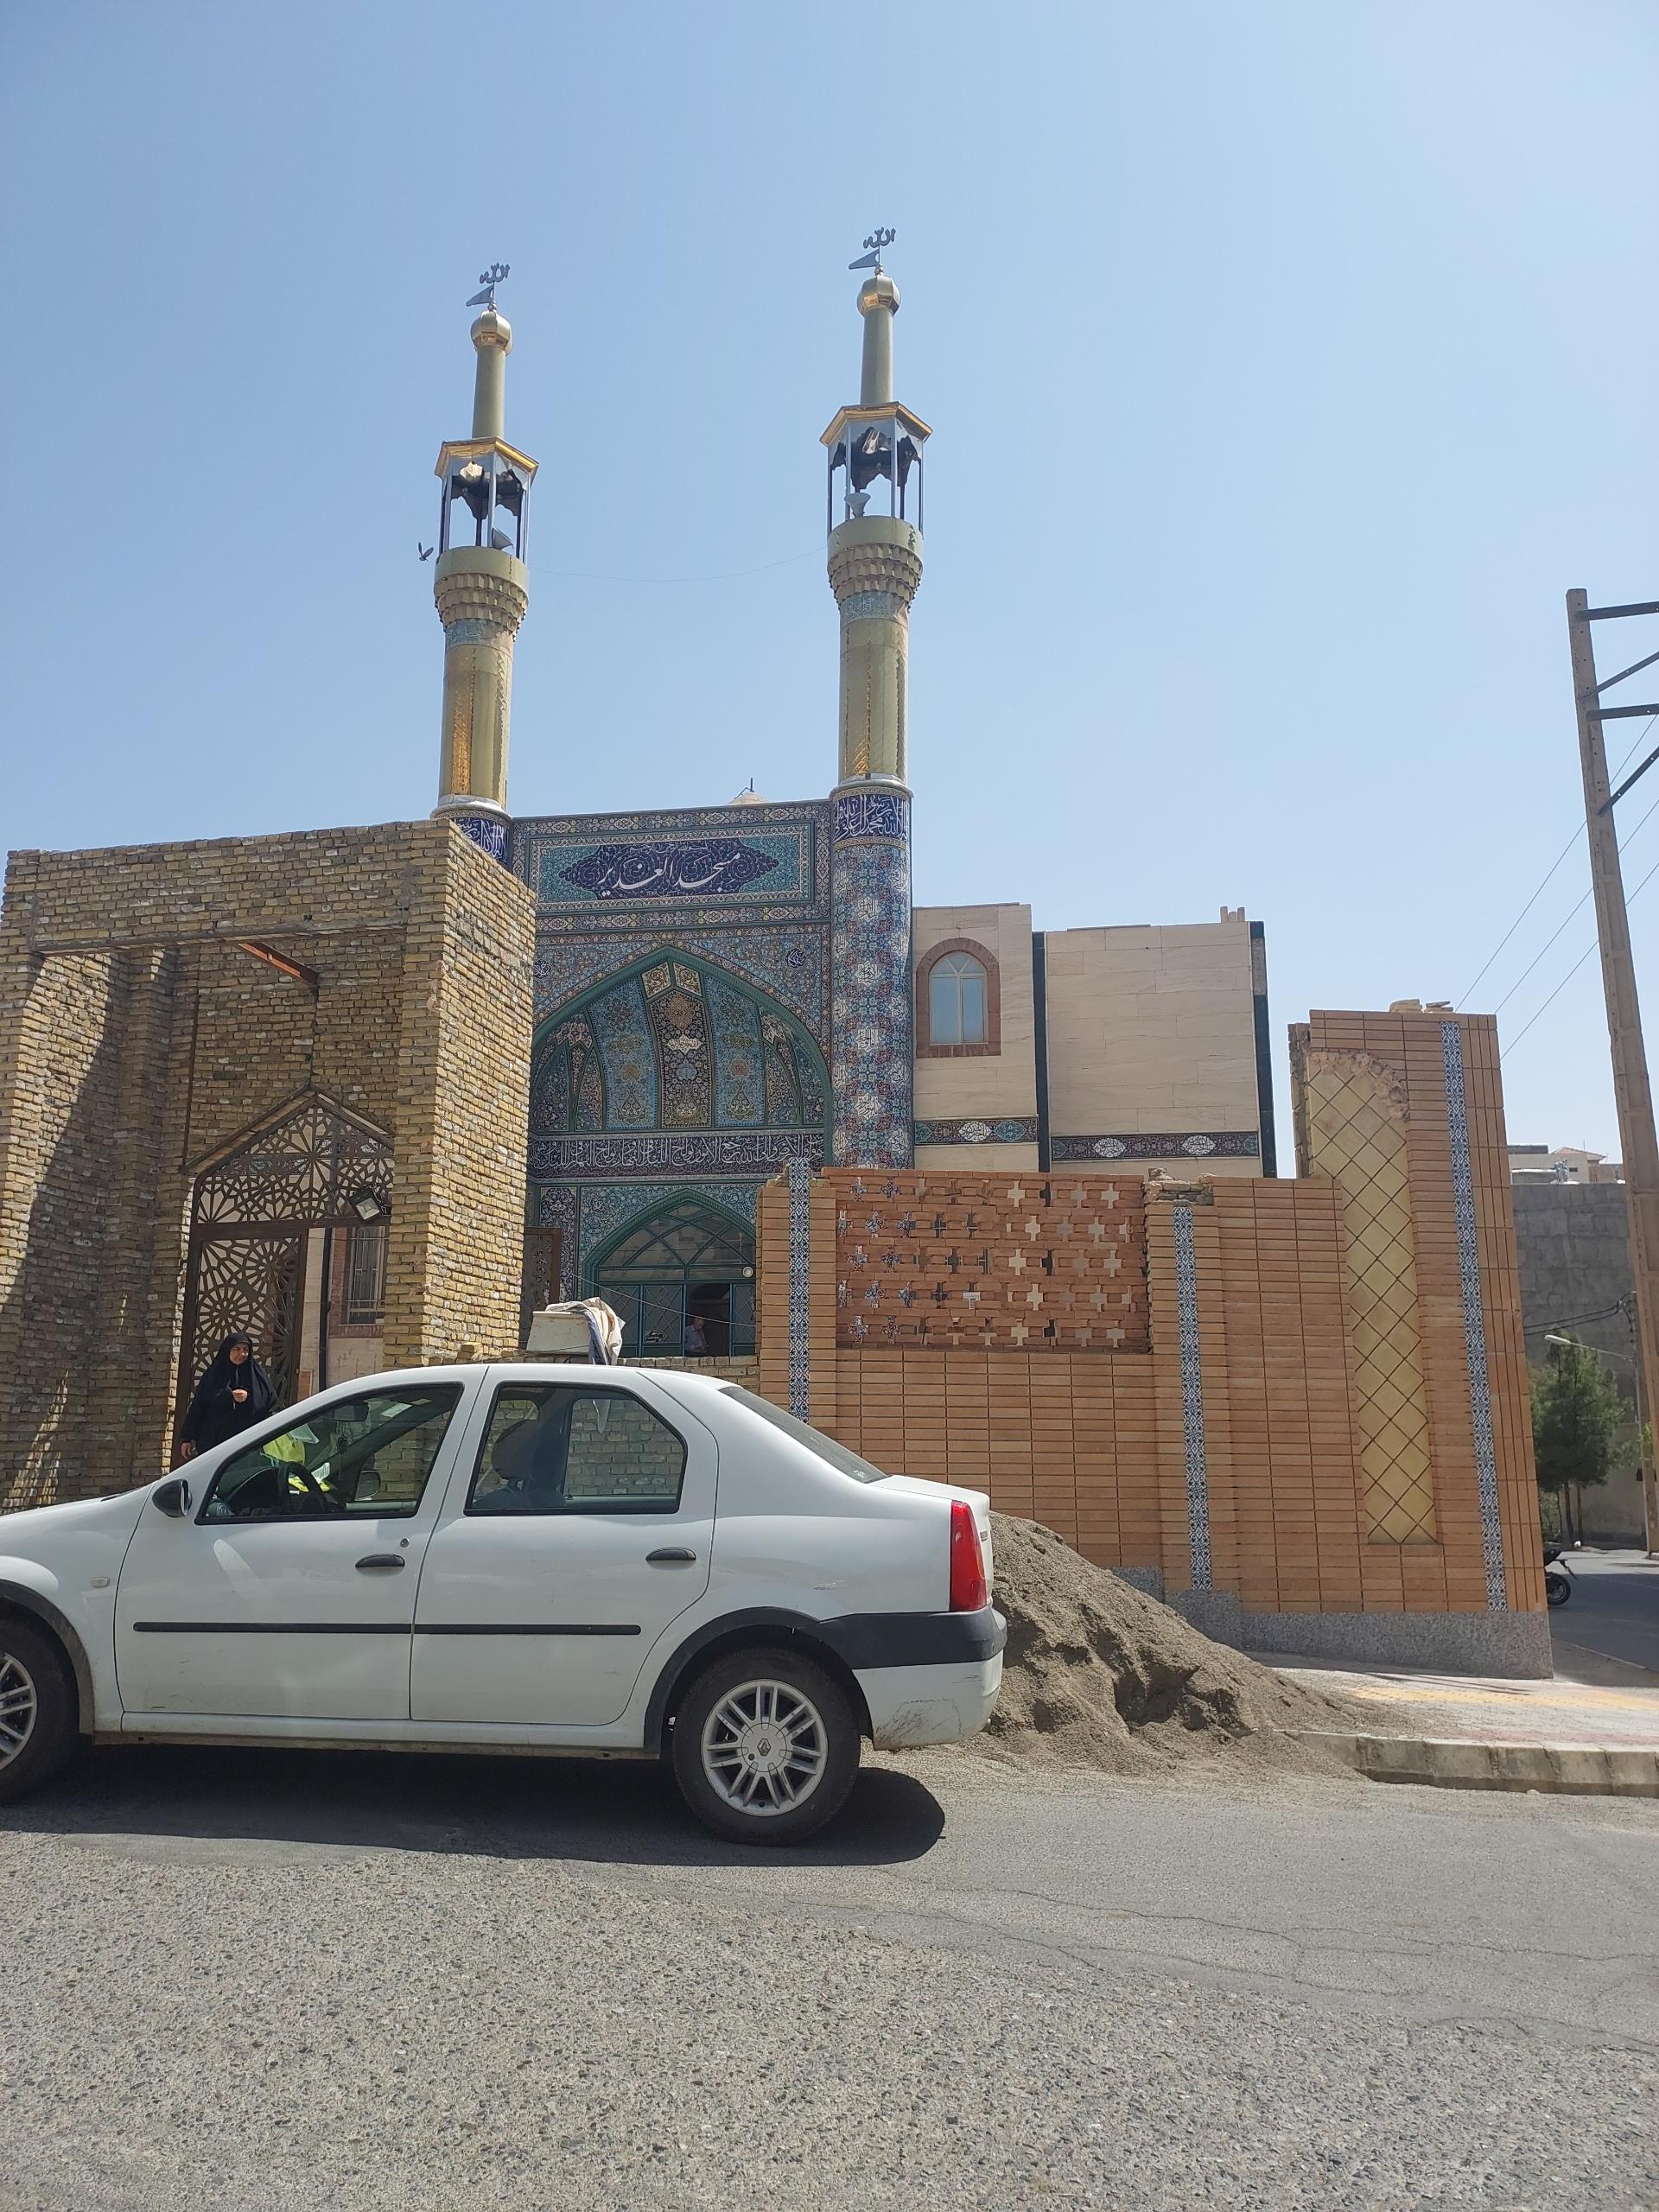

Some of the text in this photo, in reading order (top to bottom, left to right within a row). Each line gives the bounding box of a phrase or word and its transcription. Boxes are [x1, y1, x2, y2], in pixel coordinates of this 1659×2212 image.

[863, 226, 896, 249] الله
[480, 263, 510, 283] الله
[597, 852, 741, 897] مسجد الغدیر
